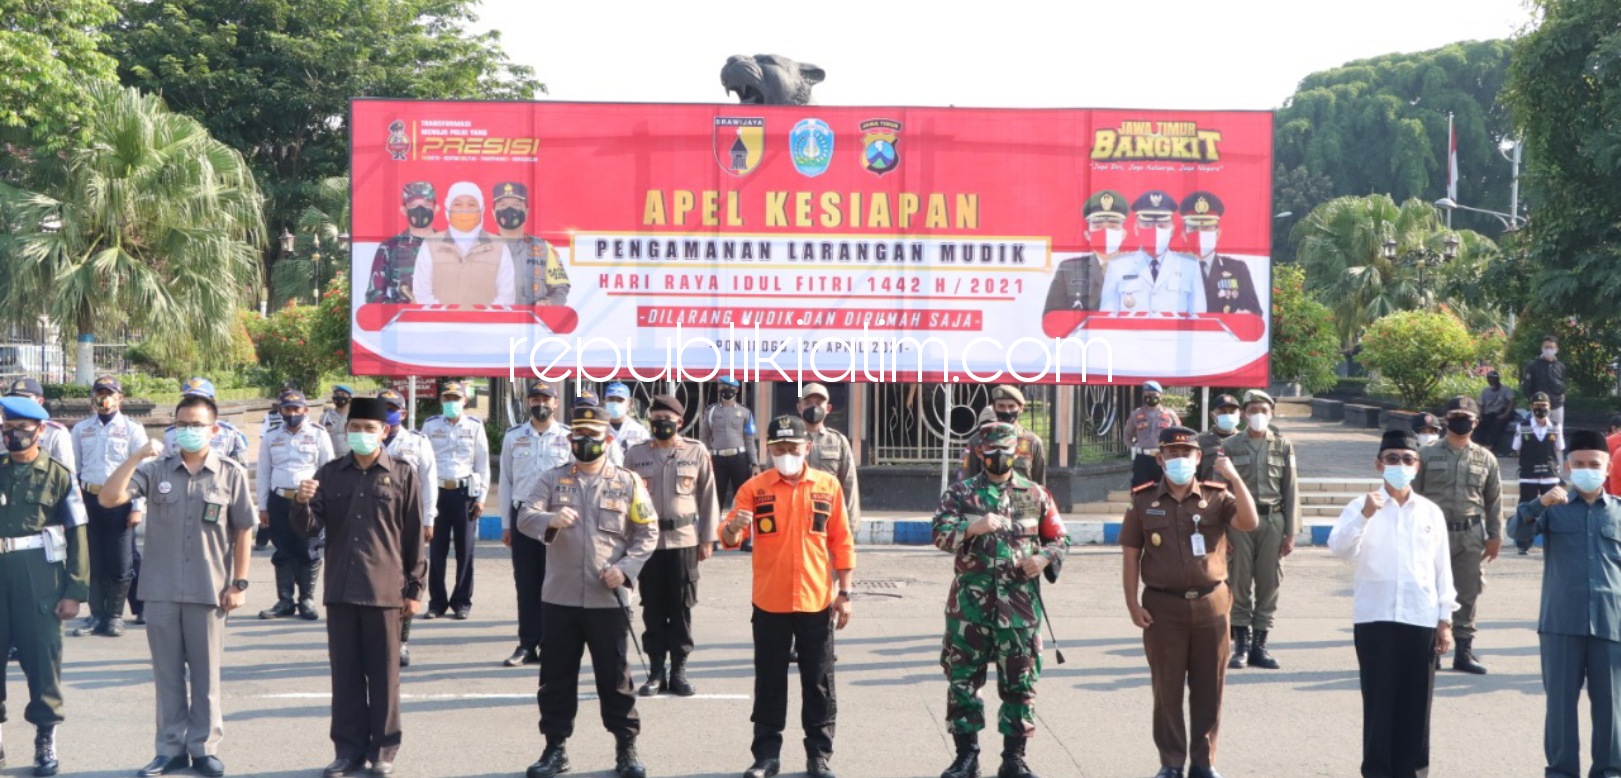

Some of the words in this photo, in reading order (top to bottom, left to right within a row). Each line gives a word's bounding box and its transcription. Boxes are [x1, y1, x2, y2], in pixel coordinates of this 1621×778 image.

[715, 118, 763, 126] BRAWIJAYA
[1117, 120, 1152, 136] JAWA
[1156, 121, 1196, 136] TIMUR
[422, 137, 540, 155] PRESISI
[1090, 129, 1222, 162] BANGKIT
[642, 189, 745, 227] APEL
[764, 191, 981, 230] KESIAPAN
[595, 239, 773, 261] PENGAMANAN
[786, 241, 925, 263] LARANGAN
[939, 243, 1027, 265] MUDIK
[600, 273, 650, 290] HARI
[665, 274, 719, 291] RAYA
[733, 275, 782, 291] IDUL
[796, 275, 852, 292] FITRI
[866, 277, 921, 293] 1442
[639, 308, 732, 325] -DILARANG
[741, 310, 795, 326] MUDIK
[802, 311, 837, 327] DAN
[844, 312, 922, 328] DIRUMAH
[929, 313, 981, 329] SAJA-
